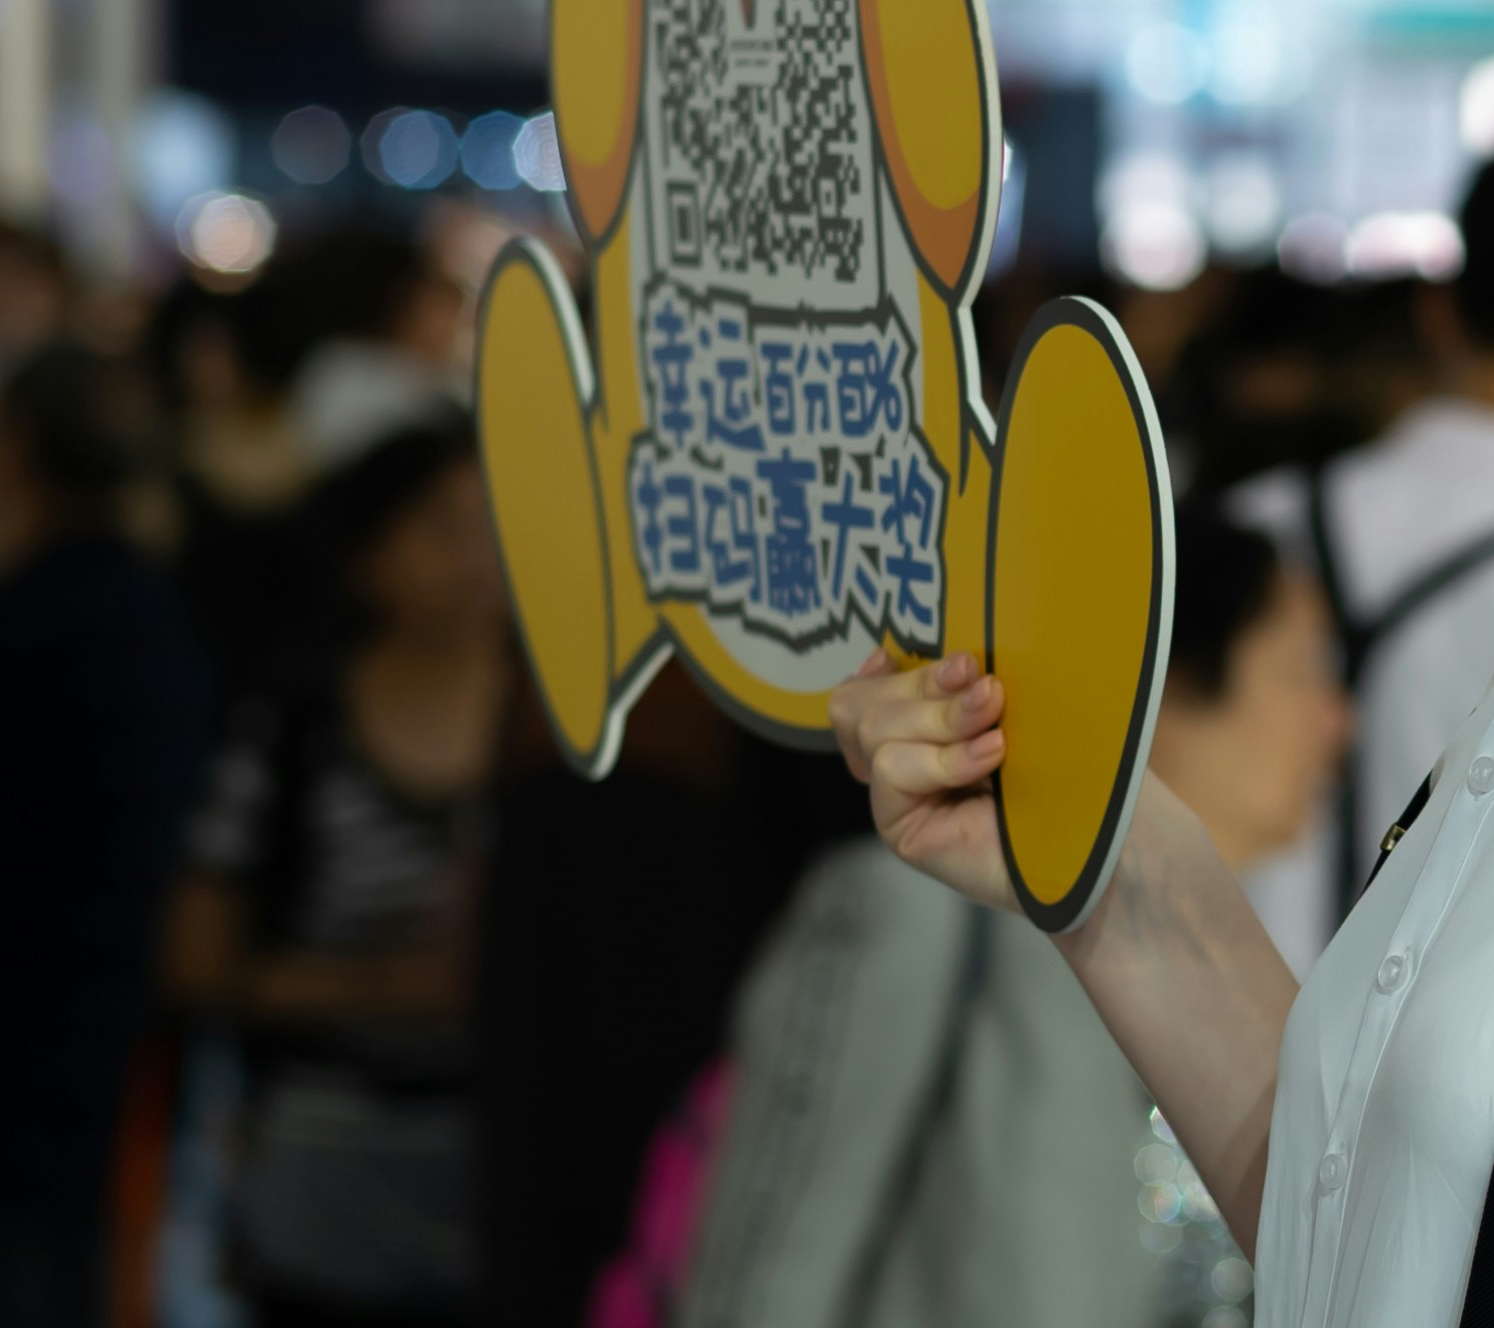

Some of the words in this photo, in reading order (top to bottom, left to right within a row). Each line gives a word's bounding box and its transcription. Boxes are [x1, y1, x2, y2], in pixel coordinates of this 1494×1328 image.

[636, 446, 936, 627] 扫码赢大奖
